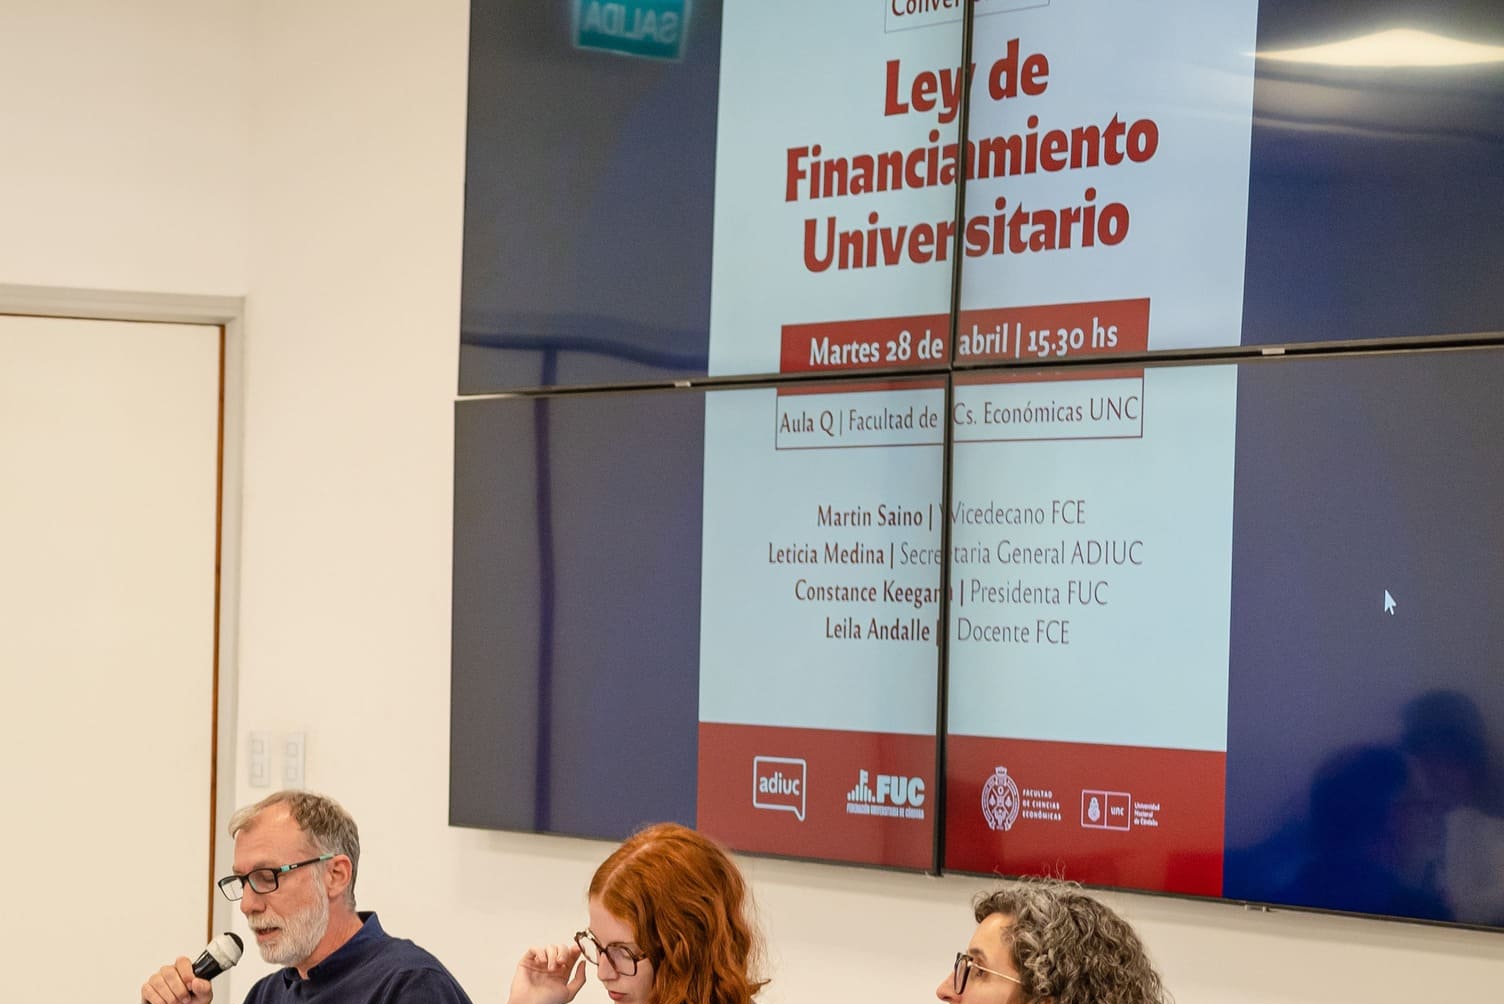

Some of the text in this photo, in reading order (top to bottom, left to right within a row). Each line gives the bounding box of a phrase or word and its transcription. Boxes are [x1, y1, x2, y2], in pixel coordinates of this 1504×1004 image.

[884, 38, 1049, 124] Ley de
[785, 112, 1159, 203] Financiamiento
[803, 187, 1130, 273] Universitario
[809, 336, 880, 366] Martes
[885, 330, 912, 361] 28
[917, 329, 944, 360] de
[959, 322, 1008, 355] abril
[1027, 327, 1084, 357] 15.30
[1091, 316, 1118, 348] hs
[779, 411, 814, 434] Aula
[819, 409, 835, 437] Q
[849, 405, 914, 432] Facultad
[918, 405, 938, 429] de
[953, 402, 977, 425] Cs.
[984, 400, 1084, 425] Económicas
[1090, 396, 1139, 421] UNC
[817, 504, 871, 527] Martin
[877, 504, 923, 527] Saino
[1051, 499, 1086, 525] FCE
[768, 541, 818, 565] Leticia
[824, 541, 885, 566] Medina
[900, 540, 991, 566] Secretaria
[997, 539, 1065, 565] General
[1071, 540, 1144, 566] ADIUC
[795, 578, 877, 603] Constance
[970, 578, 1061, 605] Presidenta
[1068, 580, 1109, 606] FUC
[826, 617, 862, 640] Leila
[867, 617, 931, 641] Andalle
[957, 617, 1031, 644] Docente
[1036, 619, 1070, 645] FCE
[759, 771, 800, 796] adiuc
